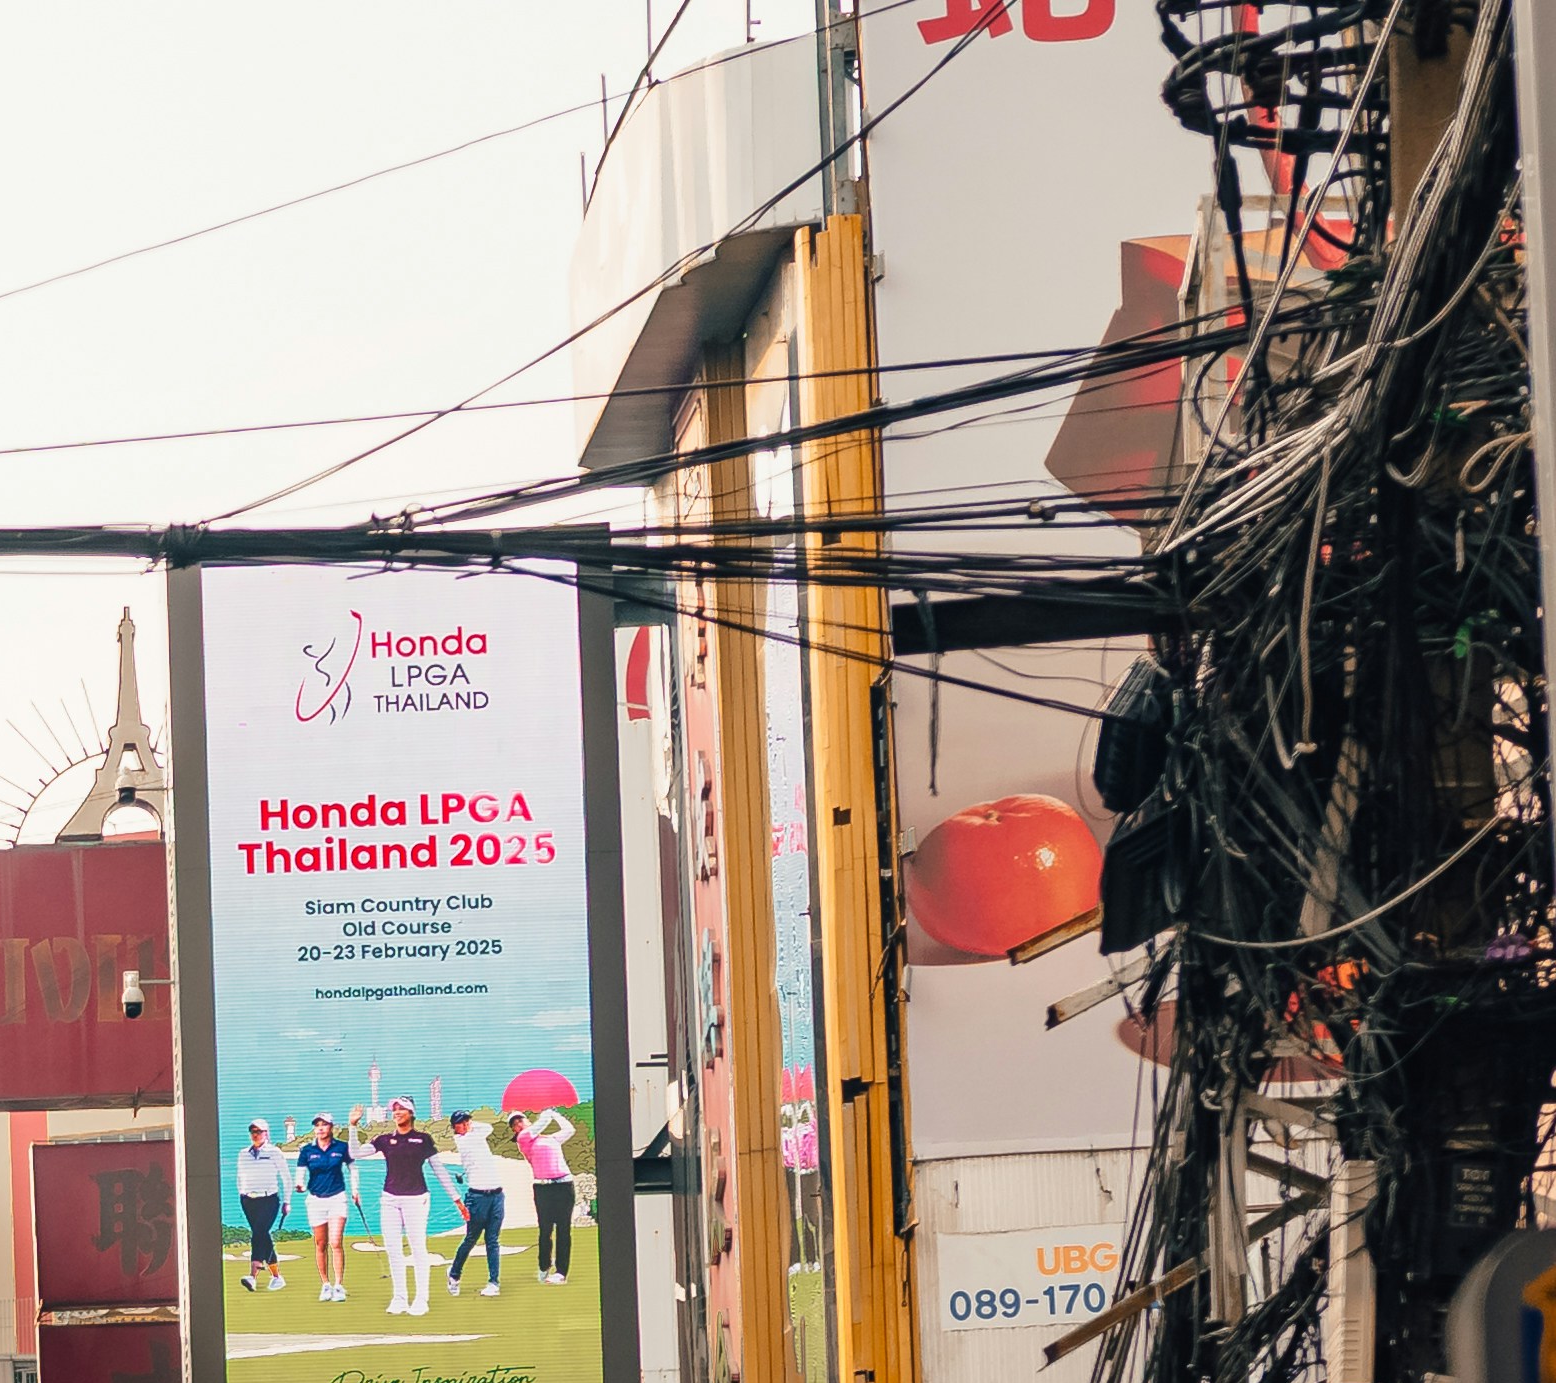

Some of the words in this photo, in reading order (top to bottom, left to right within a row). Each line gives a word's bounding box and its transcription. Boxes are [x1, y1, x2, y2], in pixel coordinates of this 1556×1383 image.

[370, 625, 489, 660] Honda
[390, 663, 471, 689] LPGA
[373, 691, 490, 714] THAILAND
[259, 794, 408, 833] Honda
[419, 790, 535, 826] LPGA
[238, 836, 439, 875] Thailand
[449, 830, 557, 868] 2025
[304, 898, 356, 917] Siam
[360, 896, 442, 920] Country
[446, 893, 494, 912] Club
[342, 919, 377, 938] Old
[381, 918, 453, 937] Course
[360, 940, 451, 965] February
[455, 939, 504, 957] 2025
[314, 981, 489, 1002] hondalpgathailand.com
[1036, 1241, 1119, 1277] UBG
